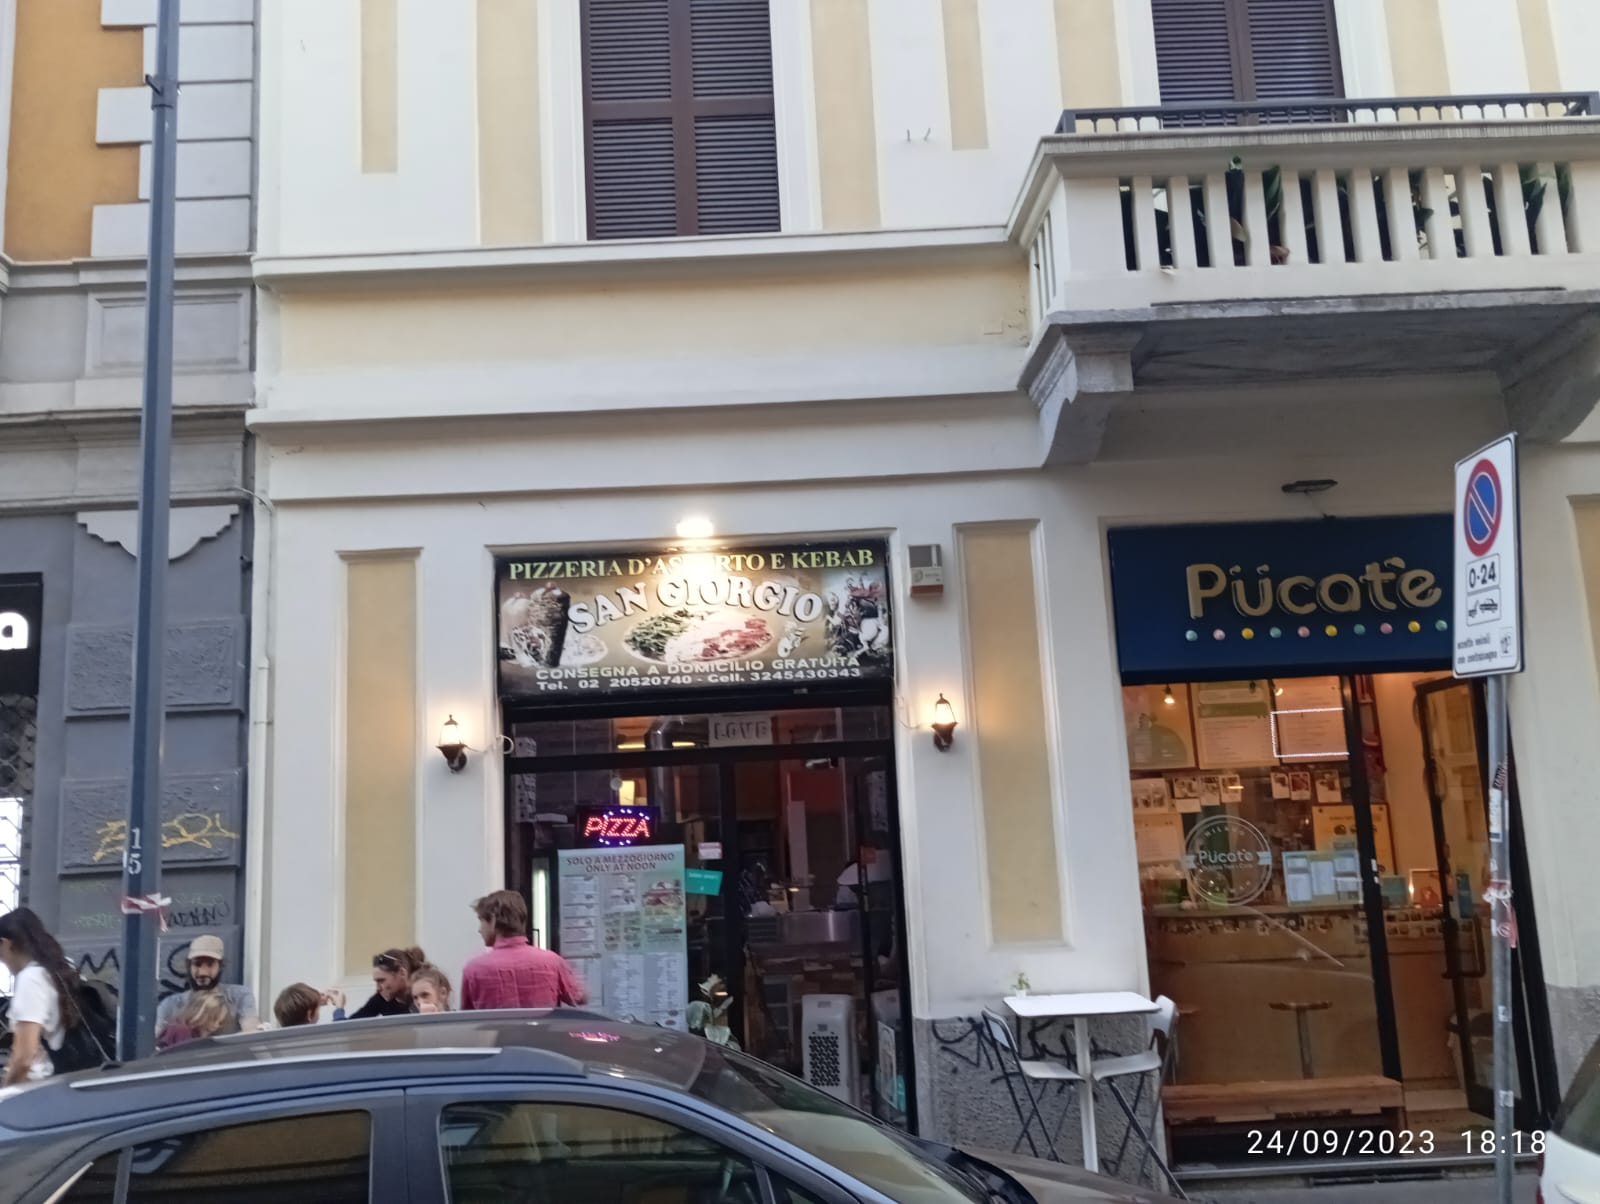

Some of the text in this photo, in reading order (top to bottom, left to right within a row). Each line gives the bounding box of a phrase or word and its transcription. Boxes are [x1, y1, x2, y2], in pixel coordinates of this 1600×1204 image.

[509, 549, 874, 580] PIZZERIA D'ASRTO E KEBAB
[1468, 560, 1497, 589] 0-24
[567, 575, 824, 634] SAN GIORGIO
[535, 656, 860, 681] CONSEGNA A DOMICILIO GRATUITA
[536, 681, 569, 691] Tel.
[578, 679, 600, 689] 02
[609, 675, 693, 688] 20520740
[707, 673, 745, 684] Cell.
[751, 667, 861, 682] 3245430343
[584, 816, 650, 838] PIZZA
[566, 852, 675, 866] SOLO A MEZZOGIORNO
[586, 862, 657, 873] ONLY AT NOON
